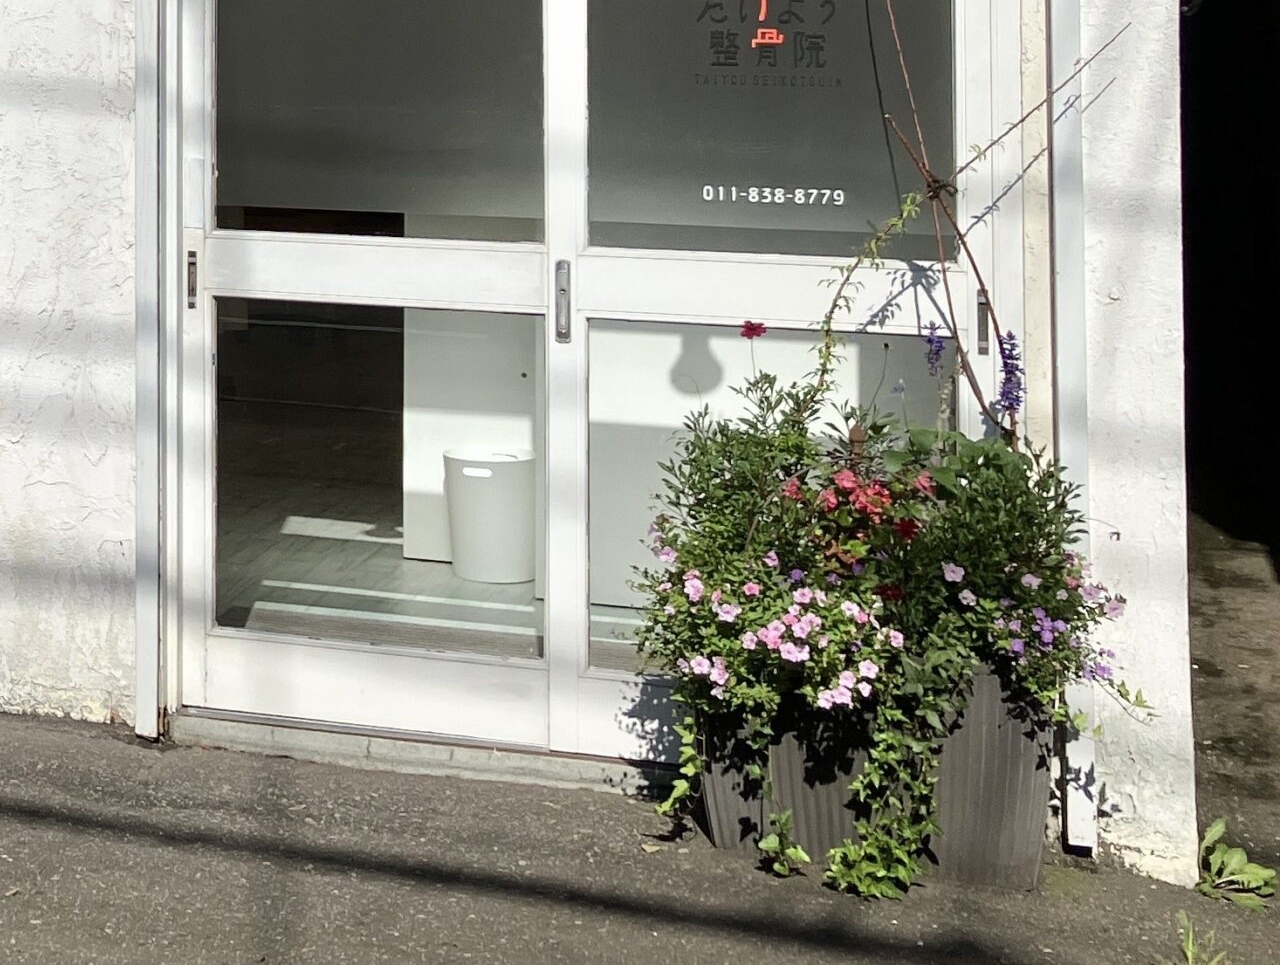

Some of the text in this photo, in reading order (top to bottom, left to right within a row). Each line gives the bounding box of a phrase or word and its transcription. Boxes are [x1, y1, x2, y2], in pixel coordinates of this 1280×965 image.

[710, 28, 827, 69] 整骨院
[702, 185, 845, 205] 011-838-8779
